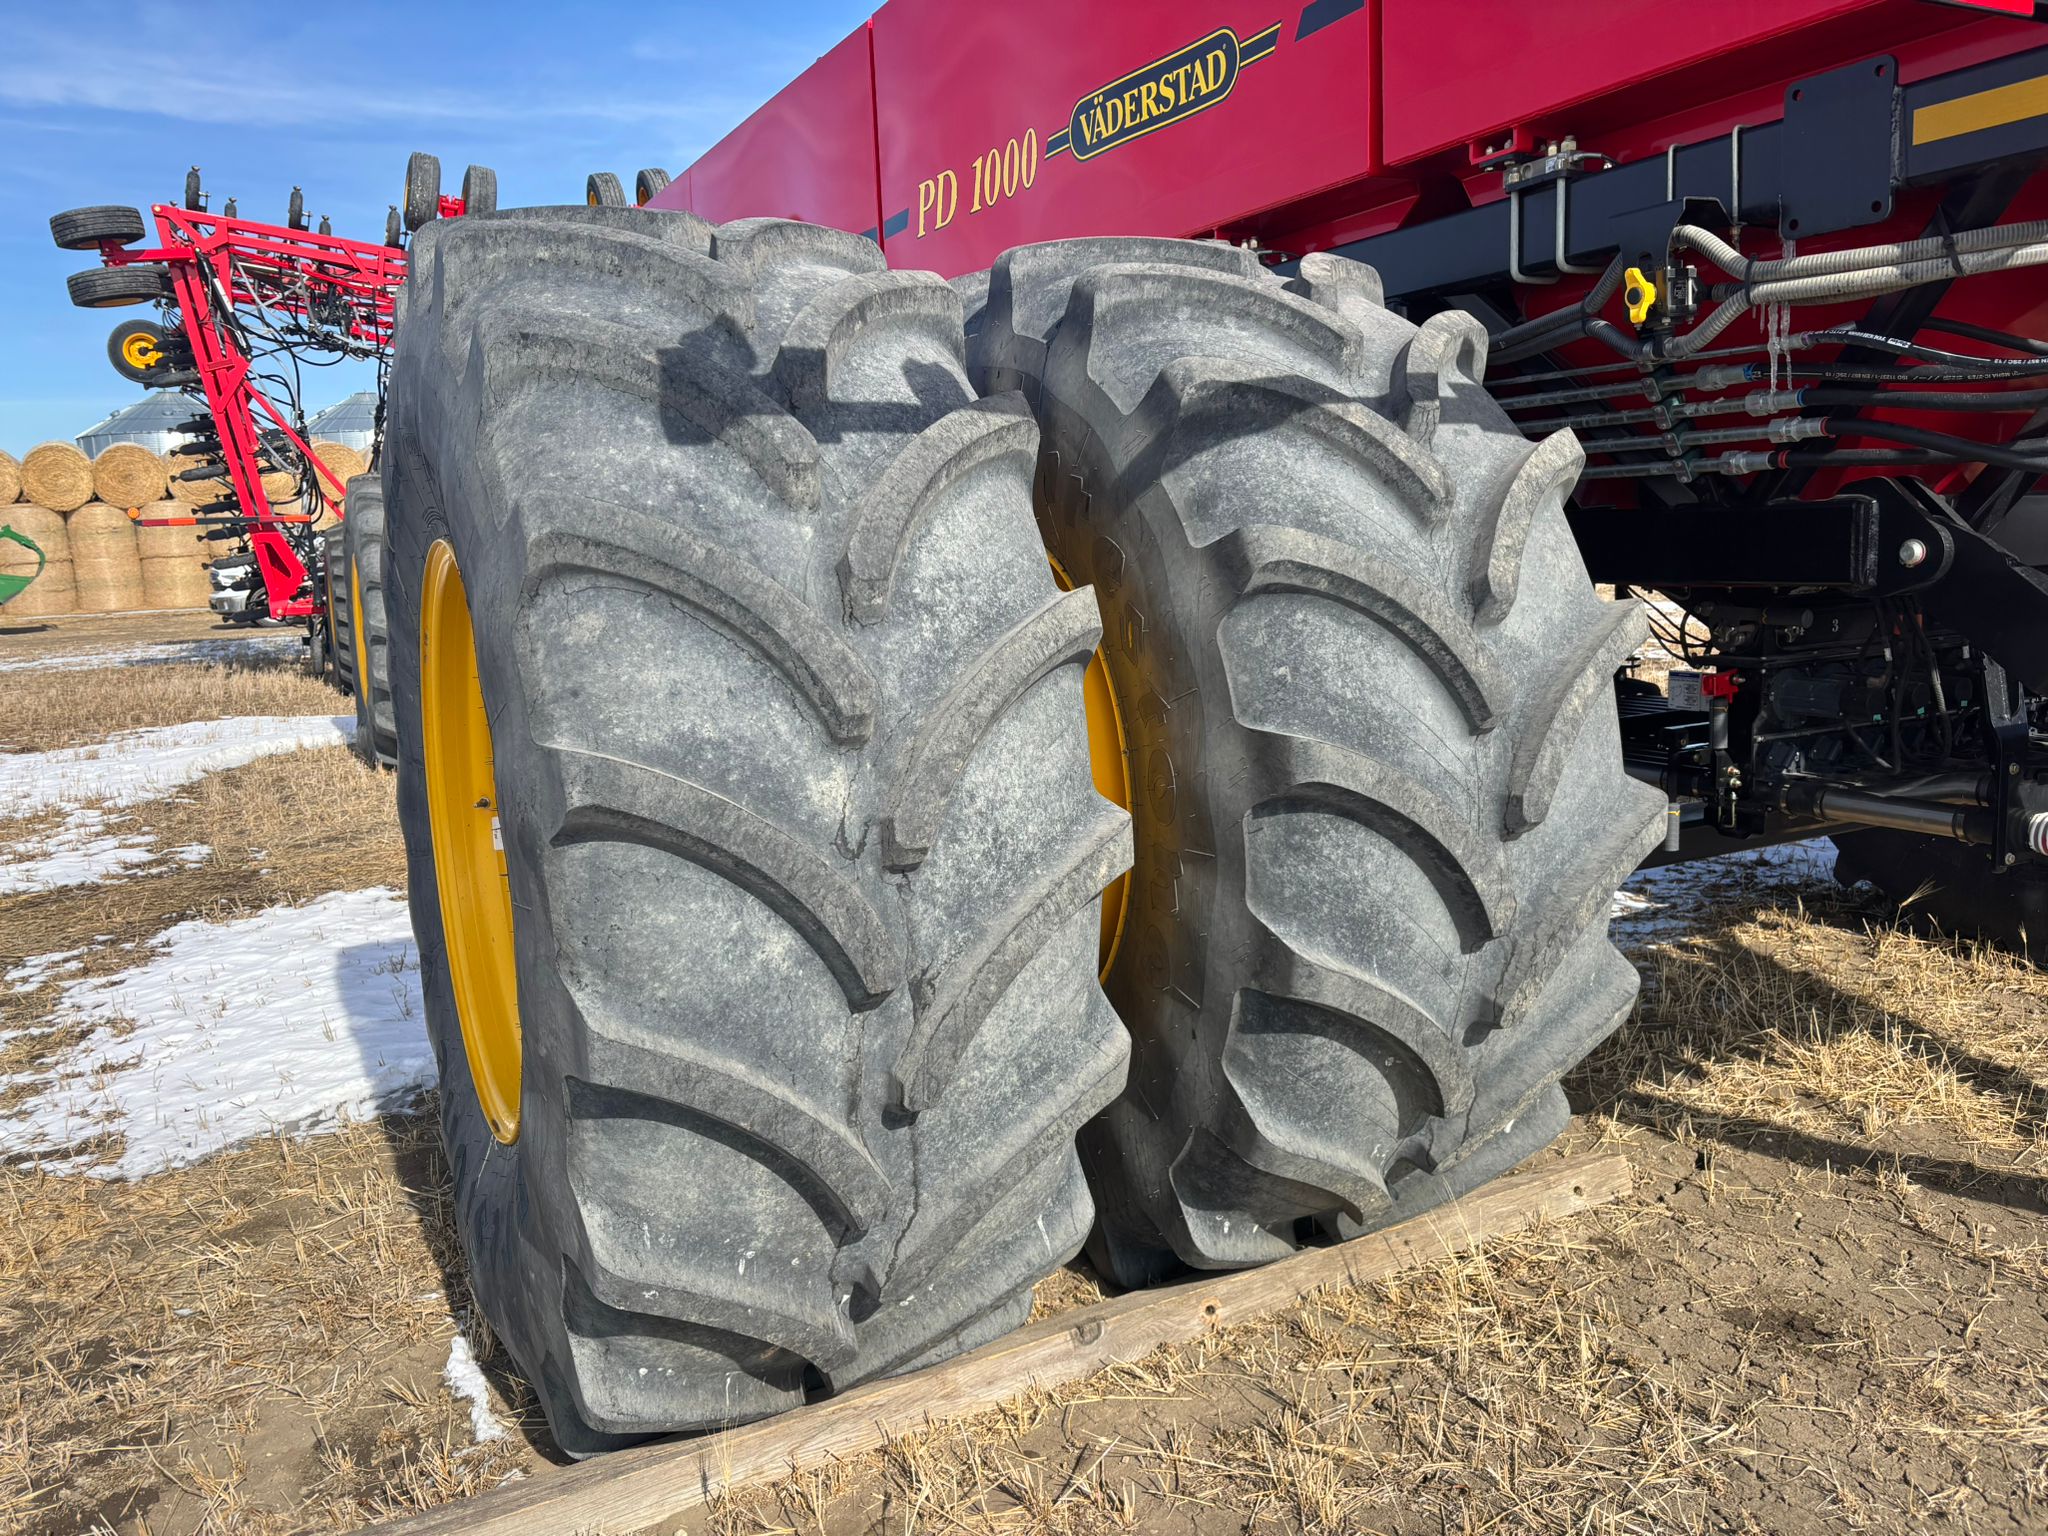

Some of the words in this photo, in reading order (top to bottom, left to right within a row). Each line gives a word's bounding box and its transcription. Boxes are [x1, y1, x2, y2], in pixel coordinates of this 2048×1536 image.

[1079, 49, 1227, 146] VÄDERSTAD
[917, 169, 958, 239] PD
[970, 127, 1038, 215] 1000
